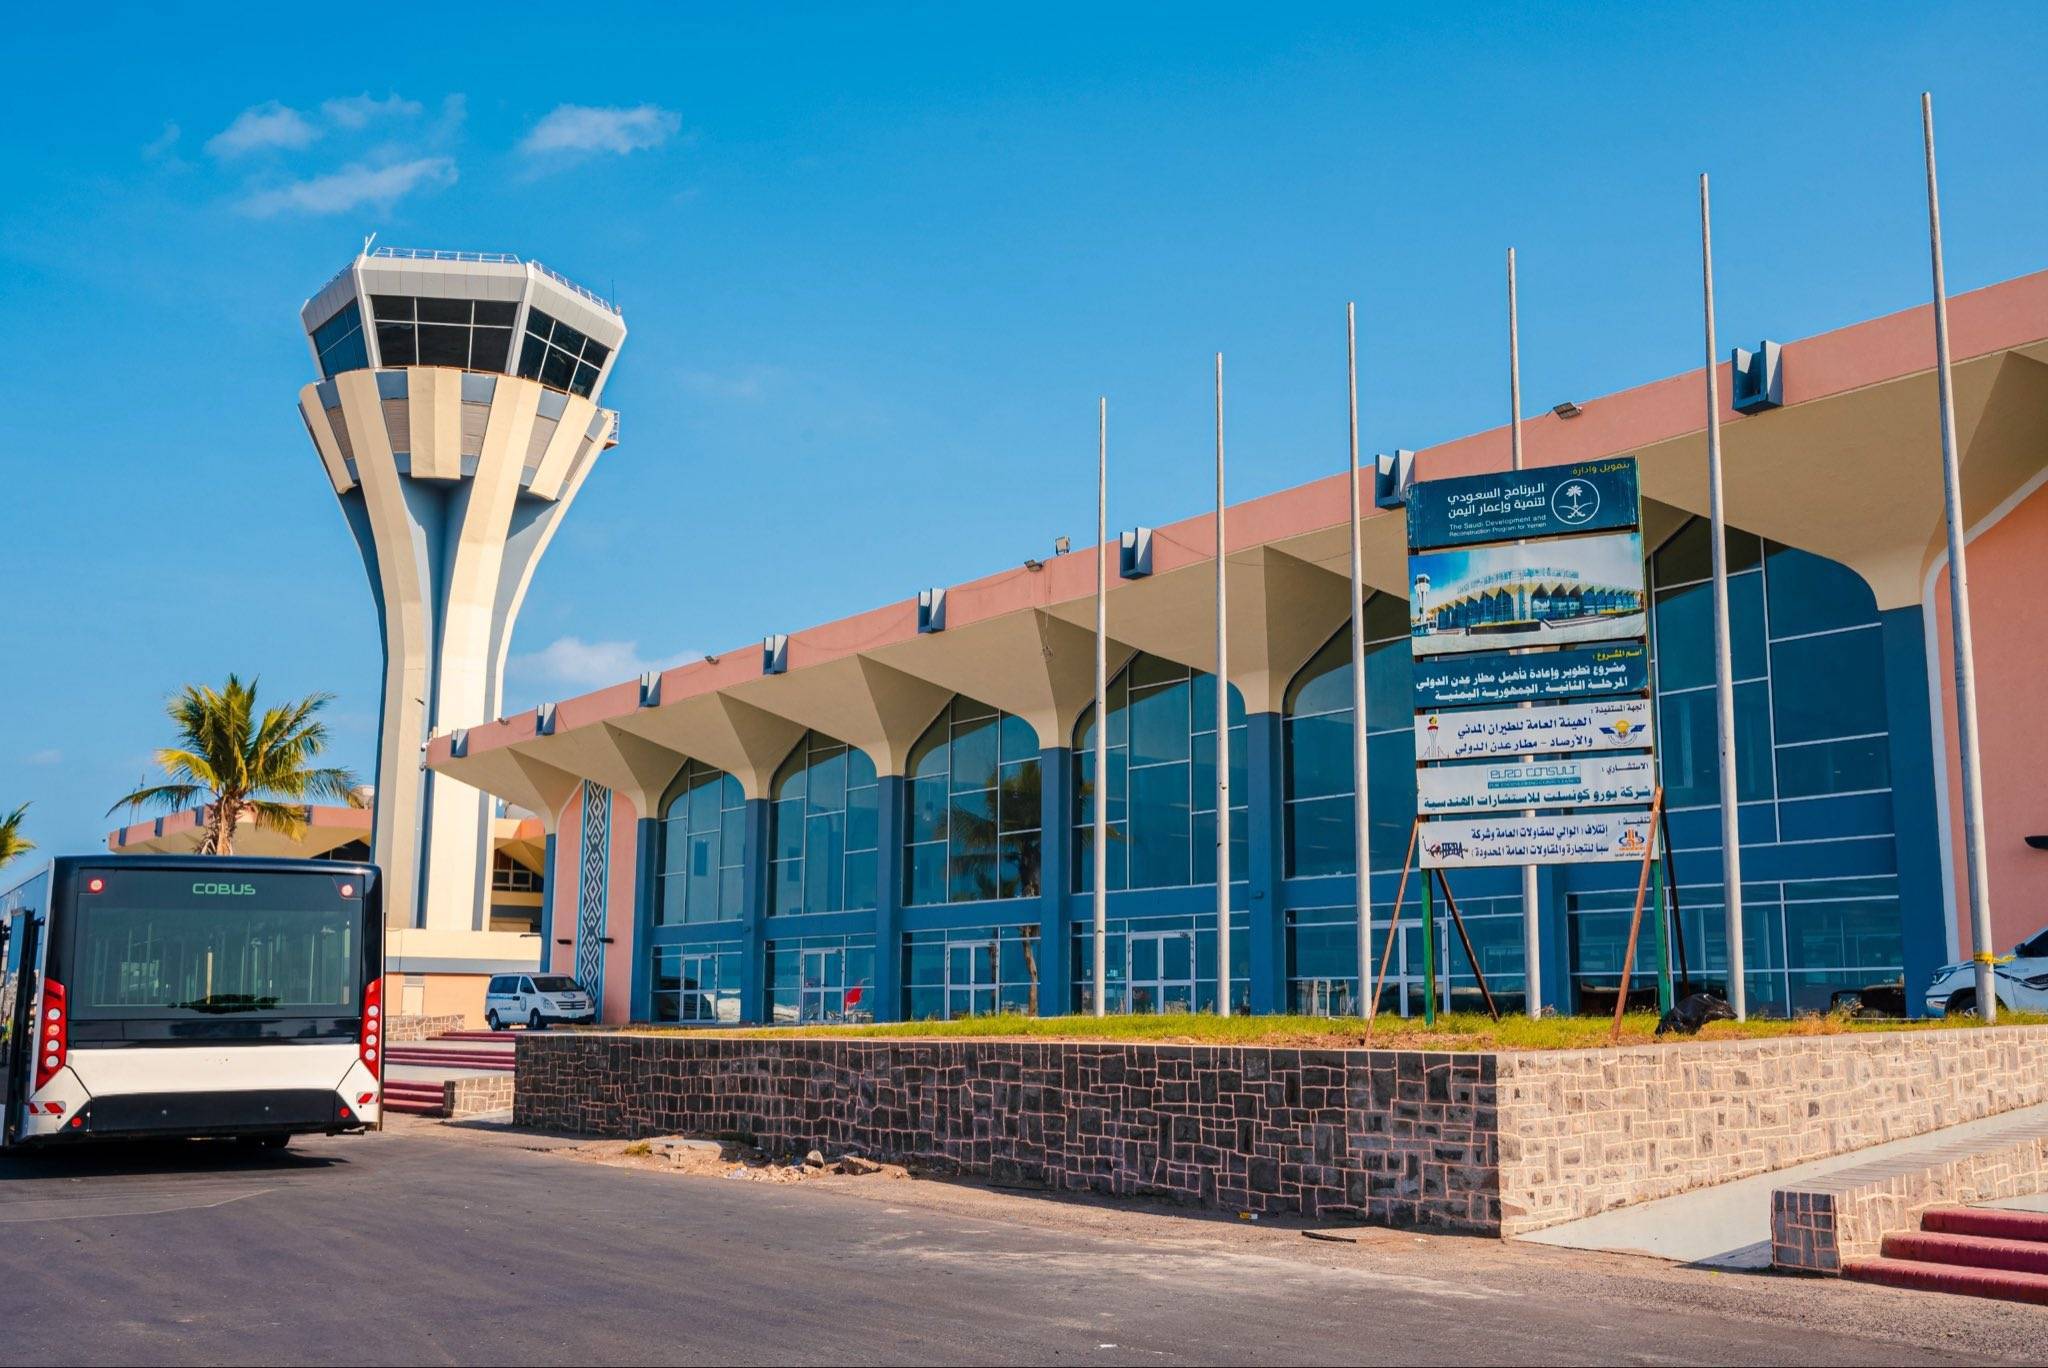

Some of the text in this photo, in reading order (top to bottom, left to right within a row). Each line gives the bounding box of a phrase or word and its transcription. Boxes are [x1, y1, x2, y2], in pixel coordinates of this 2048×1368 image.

[1447, 482, 1545, 503] البرنامج السعودي
[1448, 496, 1545, 519] لتنمية وإعمار اليمن
[1449, 514, 1546, 531] The Saudi Development and
[1449, 528, 1491, 537] Reconstruction
[1492, 525, 1516, 534] Program
[1526, 521, 1547, 529] Yemen
[1597, 650, 1625, 662] المشروع
[1626, 648, 1642, 657] اسم
[1416, 661, 1626, 692] مشروع تطوير وإعادة تأهيل مطار عدن الدولي
[1588, 676, 1628, 690] المرحلة
[1481, 683, 1538, 699] الجمهورية
[1545, 680, 1585, 694] الثانية
[1435, 687, 1479, 702] اليمنية
[1595, 705, 1627, 715] المستفيدة
[1627, 703, 1646, 713] الجهة
[1488, 721, 1524, 735] للطيران
[1527, 718, 1557, 730] العامة
[1457, 723, 1485, 739] المدني
[1455, 743, 1488, 757] الدولي
[1490, 741, 1511, 752] عدن
[1514, 739, 1537, 751] مطار
[1606, 761, 1649, 775] الاستشاري
[1424, 785, 1651, 811] شركة يورو كونسلت للاستشارات الهندسية
[1471, 828, 1494, 841] وشركة
[1496, 828, 1519, 838] العامة
[1520, 826, 1554, 839] للمقاولات
[1556, 824, 1579, 840] الوالي
[1475, 847, 1505, 859] المحدودة
[1506, 845, 1528, 855] العامة
[1530, 844, 1565, 857] والمقاولات
[1567, 843, 1594, 856] للتجارة
[192, 883, 256, 895] COBUS
